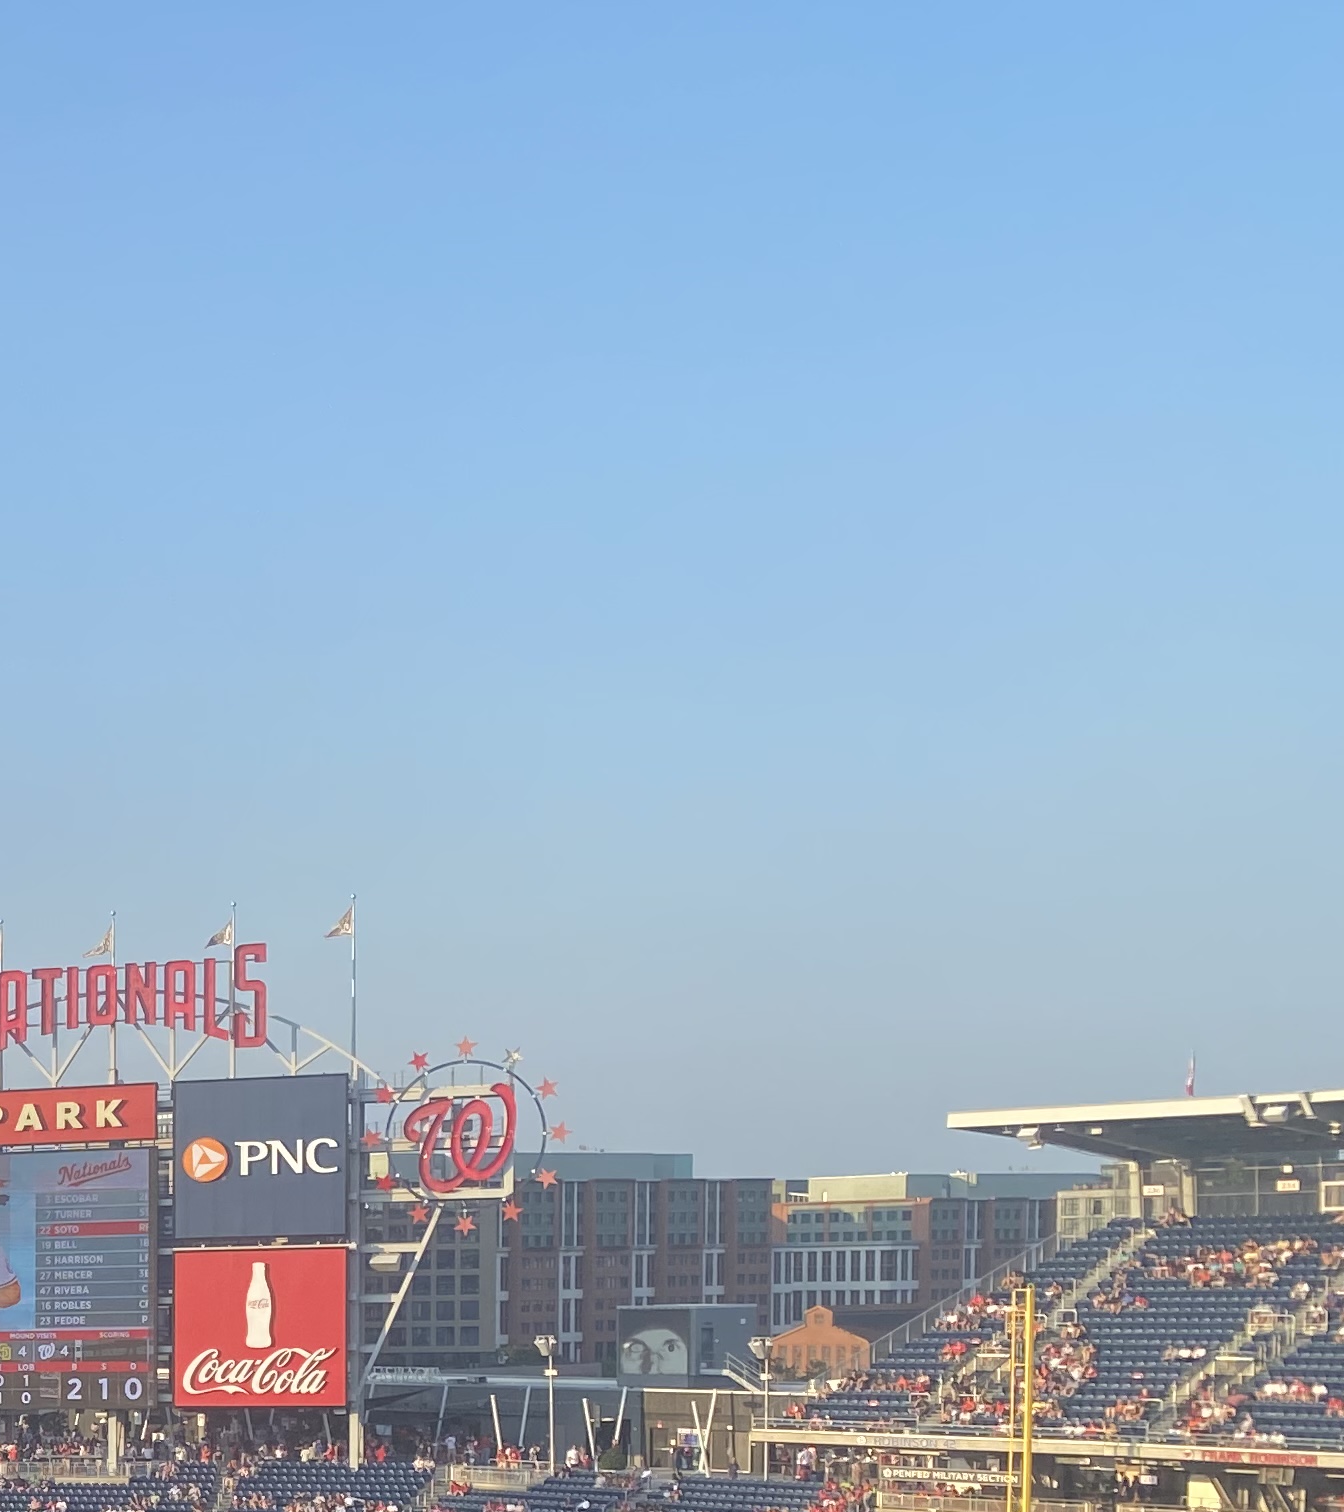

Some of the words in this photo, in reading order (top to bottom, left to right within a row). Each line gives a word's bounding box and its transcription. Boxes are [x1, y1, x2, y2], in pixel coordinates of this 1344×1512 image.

[234, 1138, 338, 1176] PNC
[57, 1153, 132, 1187] Nationals
[18, 1345, 27, 1357] 4
[60, 1345, 69, 1357] 4
[182, 1346, 337, 1396] Coca-Cola
[21, 1392, 31, 1404] 0
[67, 1377, 83, 1400] 2
[99, 1377, 109, 1400] 1
[124, 1377, 142, 1400] 0
[892, 1469, 930, 1480] PENFED
